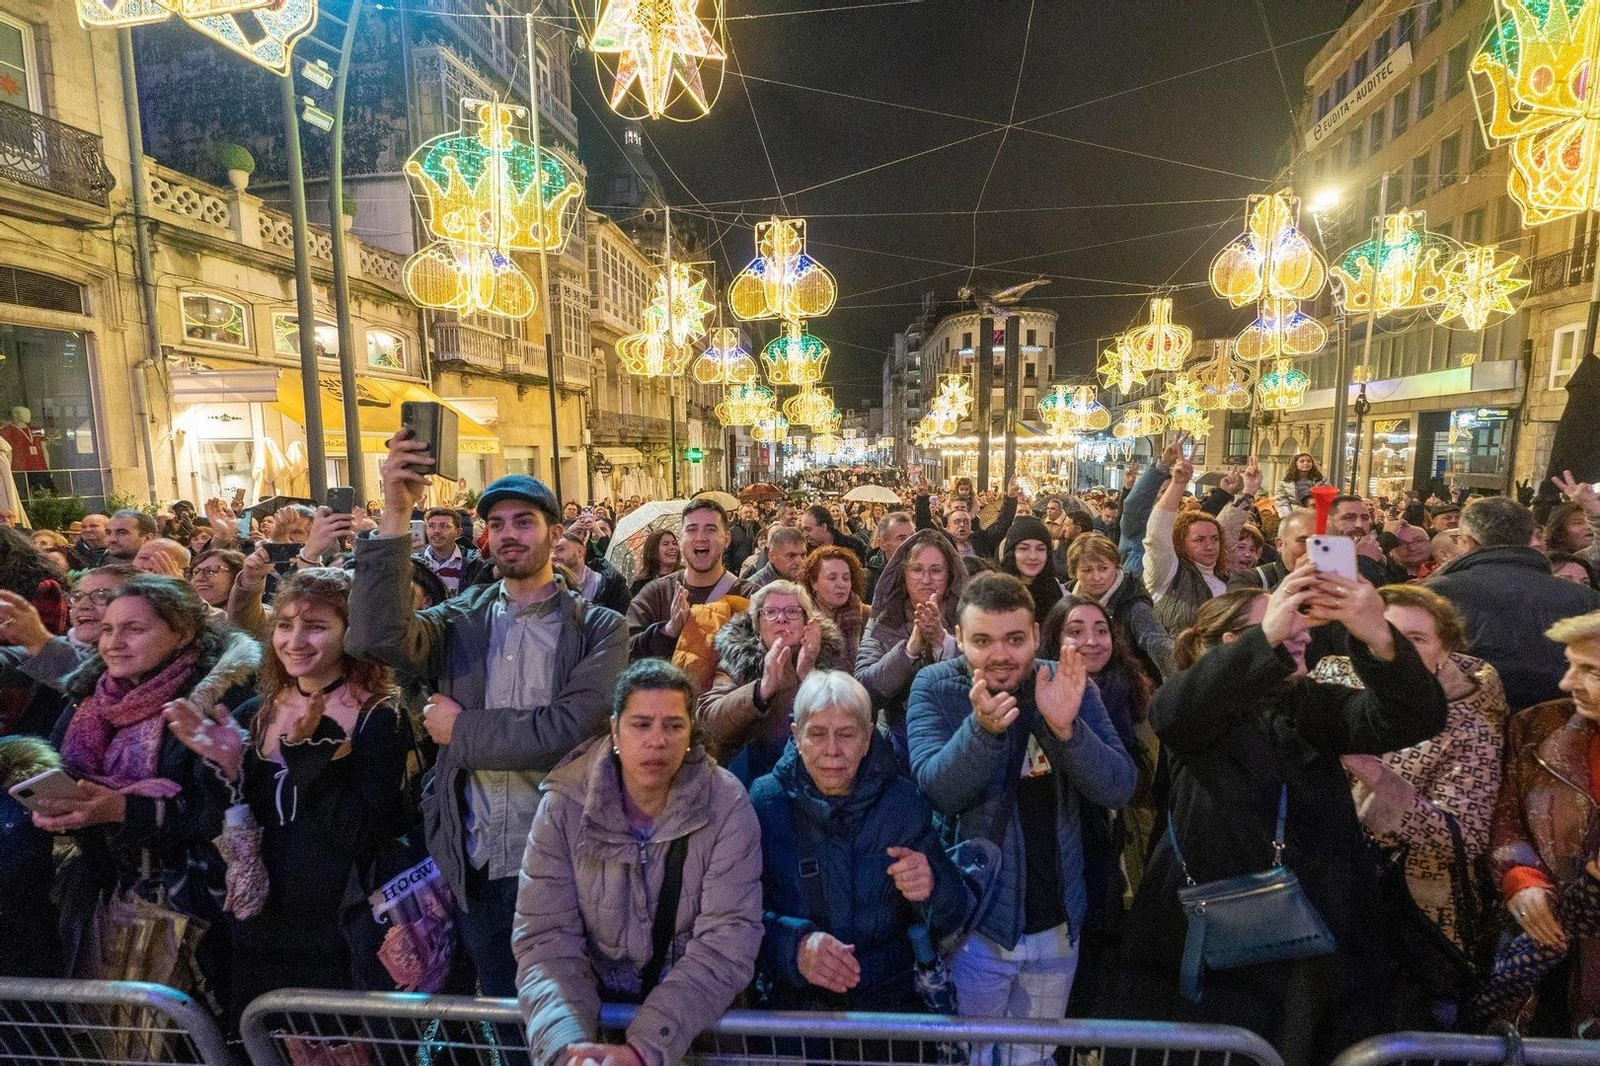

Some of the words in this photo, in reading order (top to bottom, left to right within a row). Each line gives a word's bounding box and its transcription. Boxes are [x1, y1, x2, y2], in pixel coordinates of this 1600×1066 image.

[1323, 103, 1349, 131] EUDITA
[1356, 62, 1393, 102] AUDITEC
[382, 860, 433, 902] HOGW
